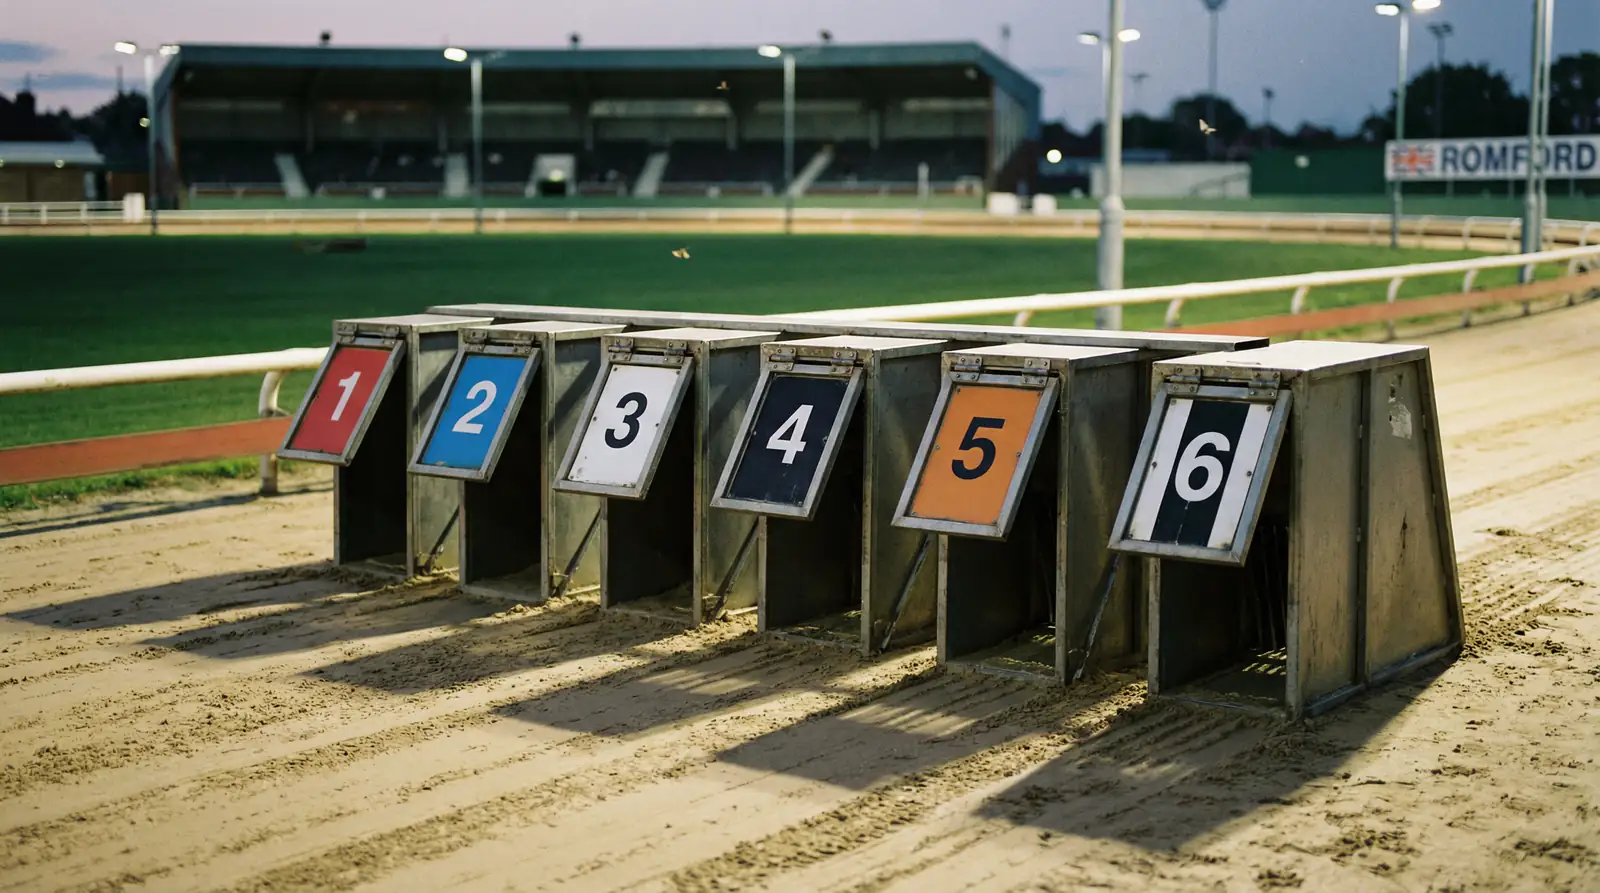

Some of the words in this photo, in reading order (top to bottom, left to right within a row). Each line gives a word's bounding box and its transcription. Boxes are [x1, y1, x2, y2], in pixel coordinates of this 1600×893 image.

[331, 371, 361, 422] 1
[452, 380, 497, 435] 2
[604, 391, 648, 449] 3
[766, 404, 814, 465] 4
[951, 416, 1006, 481] 5
[1174, 431, 1231, 502] 6
